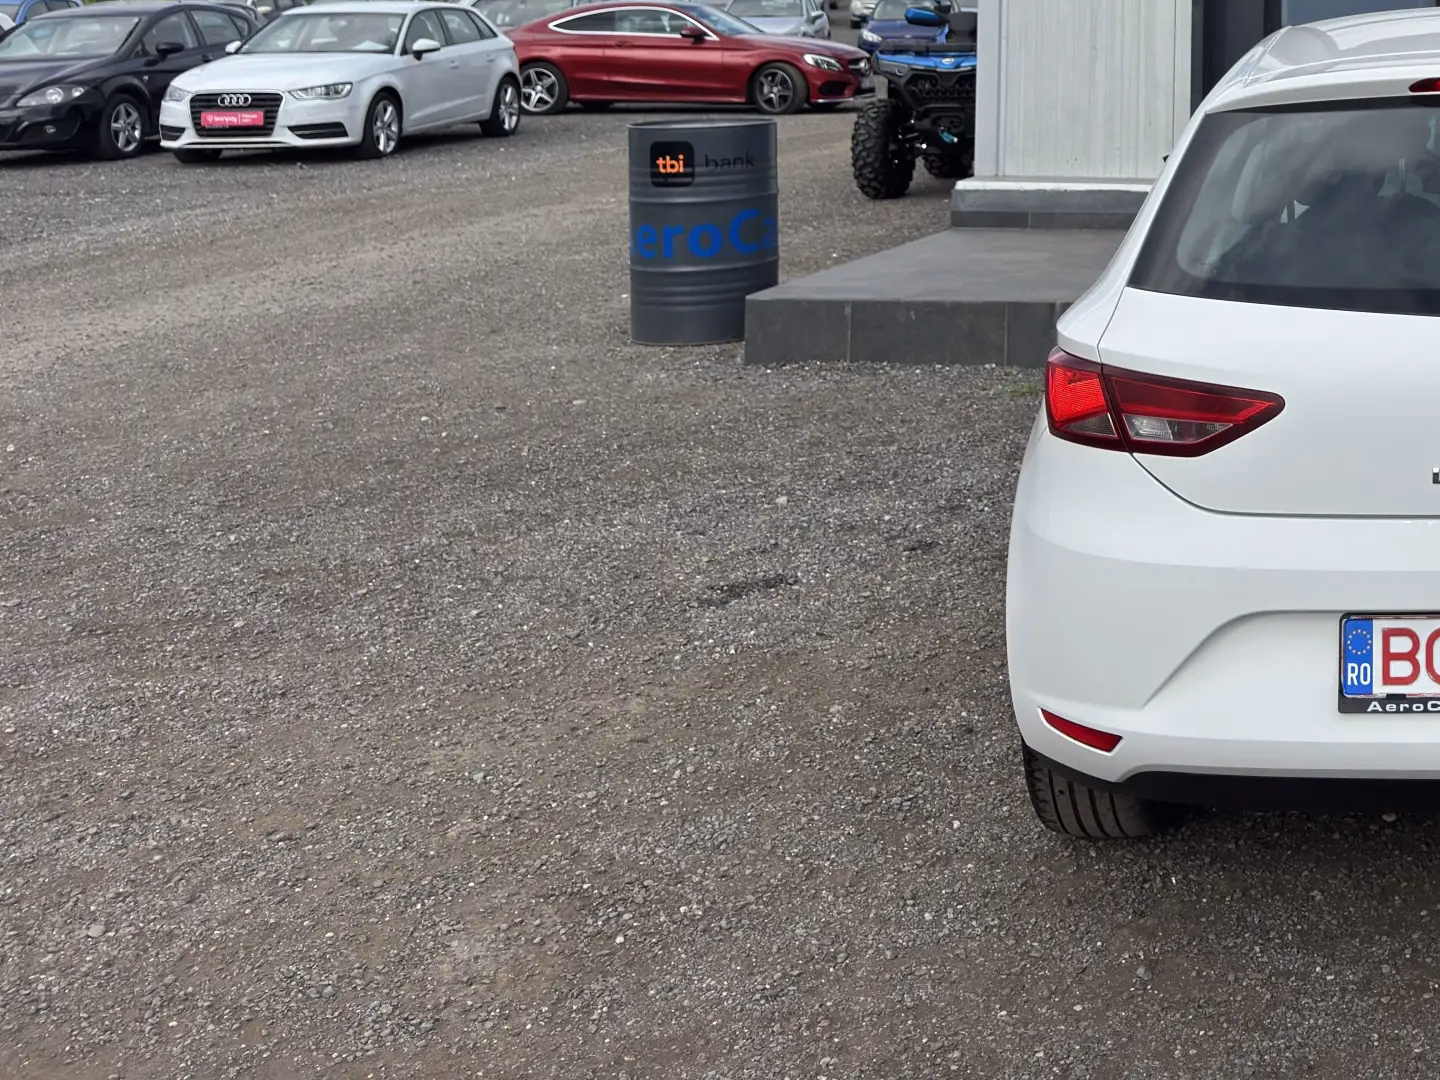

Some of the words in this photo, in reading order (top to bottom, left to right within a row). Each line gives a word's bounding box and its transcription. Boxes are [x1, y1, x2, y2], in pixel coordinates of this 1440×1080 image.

[656, 153, 684, 174] tbi
[705, 152, 756, 169] bank
[1347, 662, 1371, 686] RO
